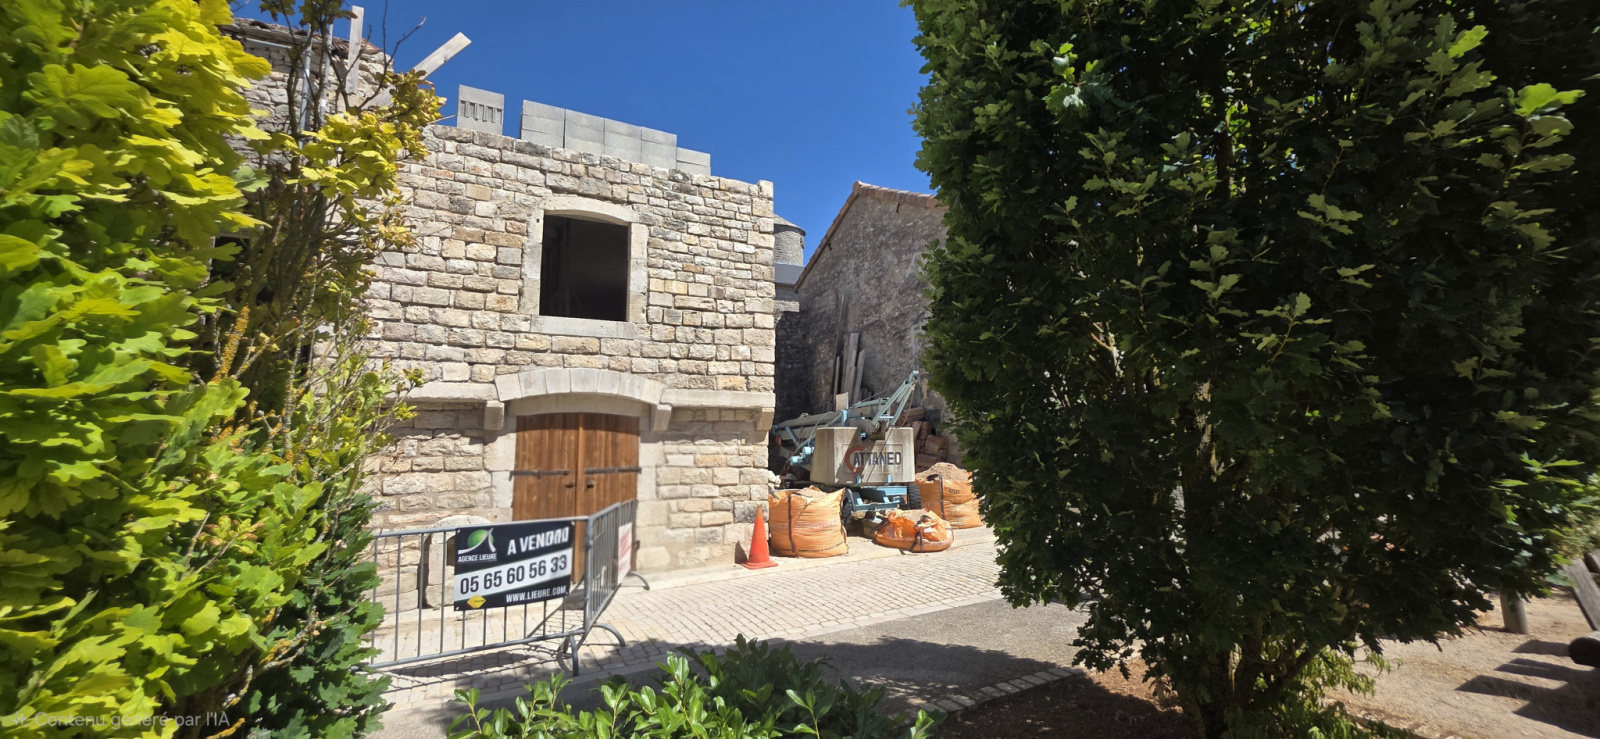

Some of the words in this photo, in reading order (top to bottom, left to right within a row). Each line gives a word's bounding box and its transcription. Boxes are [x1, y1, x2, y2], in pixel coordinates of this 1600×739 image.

[507, 538, 517, 556] A
[457, 554, 478, 563] AGENCE
[479, 552, 498, 561] LIEURE
[460, 575, 479, 595] 05
[483, 570, 503, 590] 65
[506, 565, 525, 585] 60
[529, 560, 547, 579] 56
[550, 554, 567, 573] 33
[506, 585, 567, 603] WWW.LIEURE.COM
